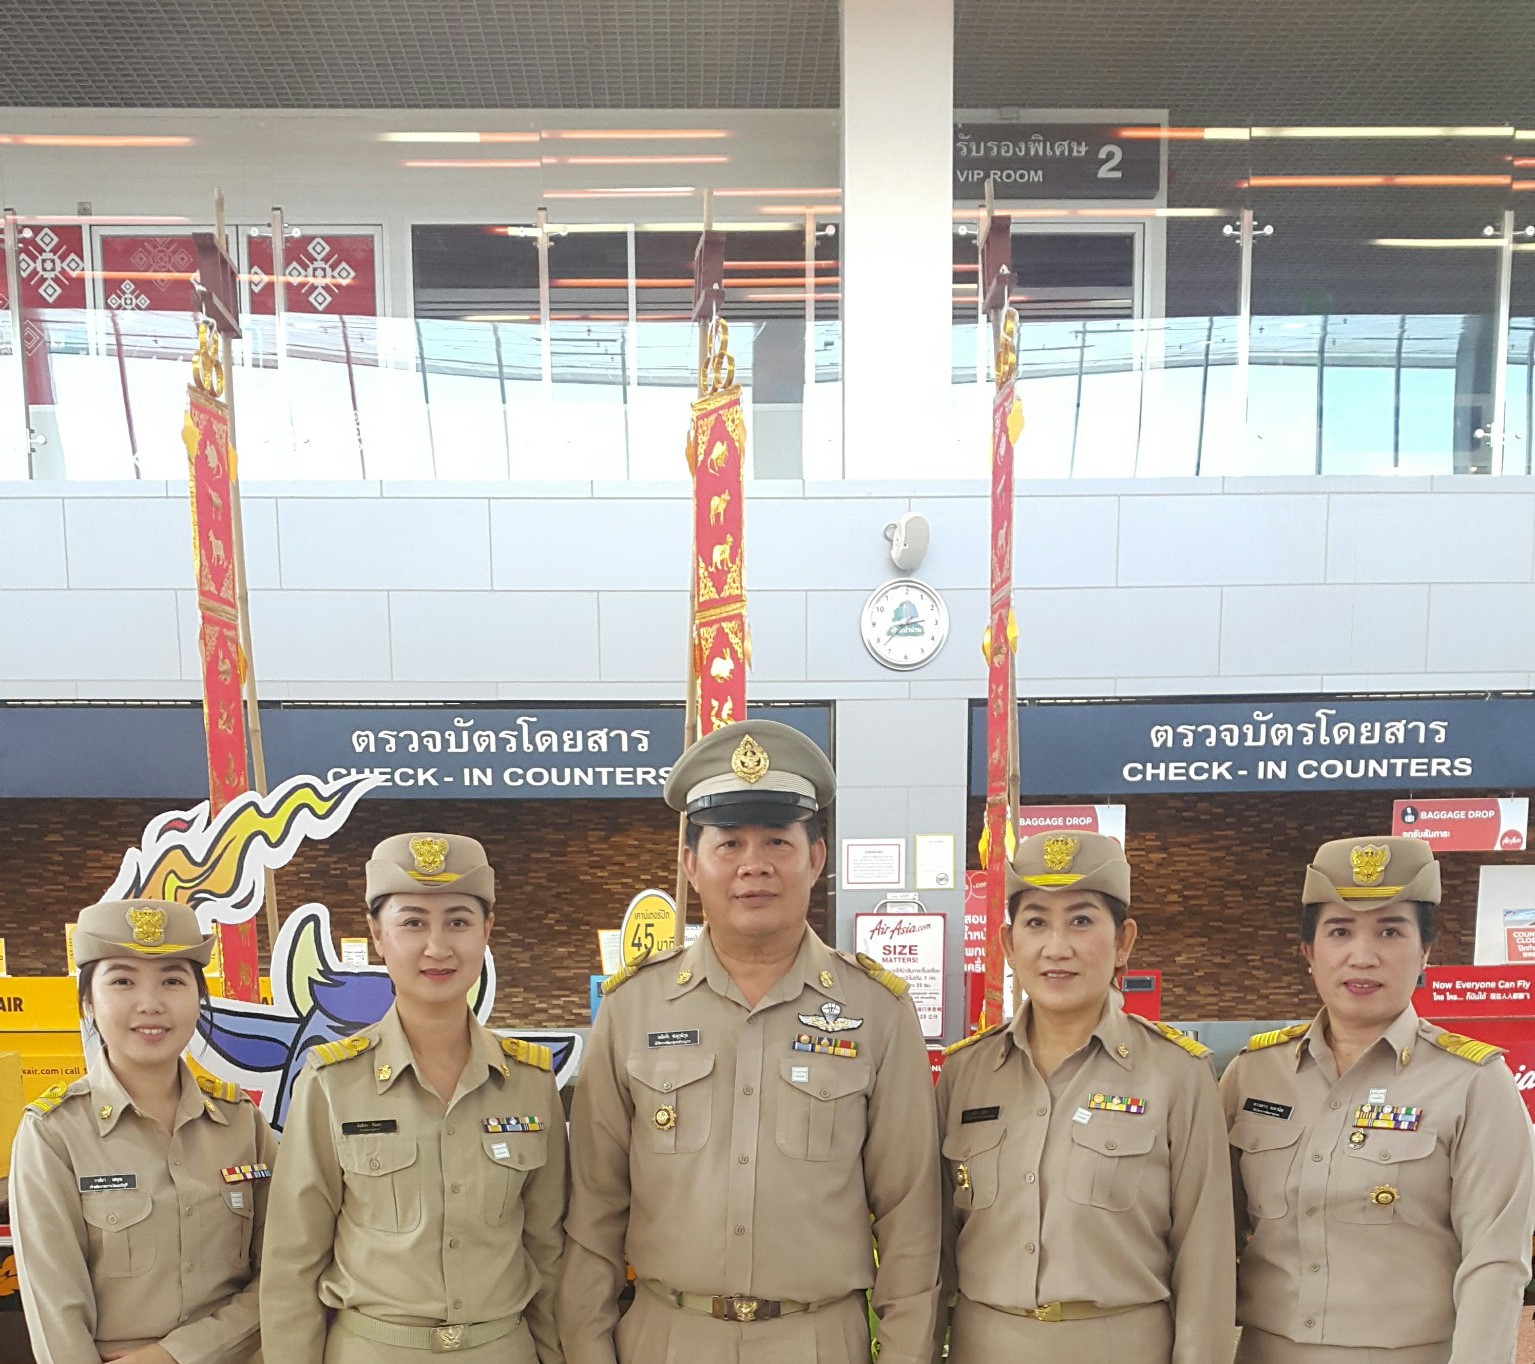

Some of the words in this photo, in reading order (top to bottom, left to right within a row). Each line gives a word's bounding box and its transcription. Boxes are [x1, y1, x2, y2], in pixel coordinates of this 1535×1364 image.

[1097, 144, 1123, 178] 2
[956, 170, 984, 182] VIP
[990, 170, 1043, 182] ROOM
[351, 716, 651, 753] ตรวจบัตรโดยสาร
[1150, 709, 1448, 748] ตรวจบัตรโดยสาร
[463, 767, 493, 786] IN
[1257, 760, 1288, 779] IN
[1298, 757, 1473, 779] COUNTERS
[1019, 817, 1064, 826] BAGGAGE
[1066, 817, 1092, 825] DROP
[1420, 811, 1466, 819] BAGGAGE
[1468, 810, 1495, 818] DROP
[631, 923, 655, 951] 45
[882, 945, 918, 956] SIZE
[1432, 981, 1453, 989] Now
[1456, 981, 1496, 989] Everyone
[1498, 980, 1515, 989] Can
[1517, 980, 1531, 989] Fly
